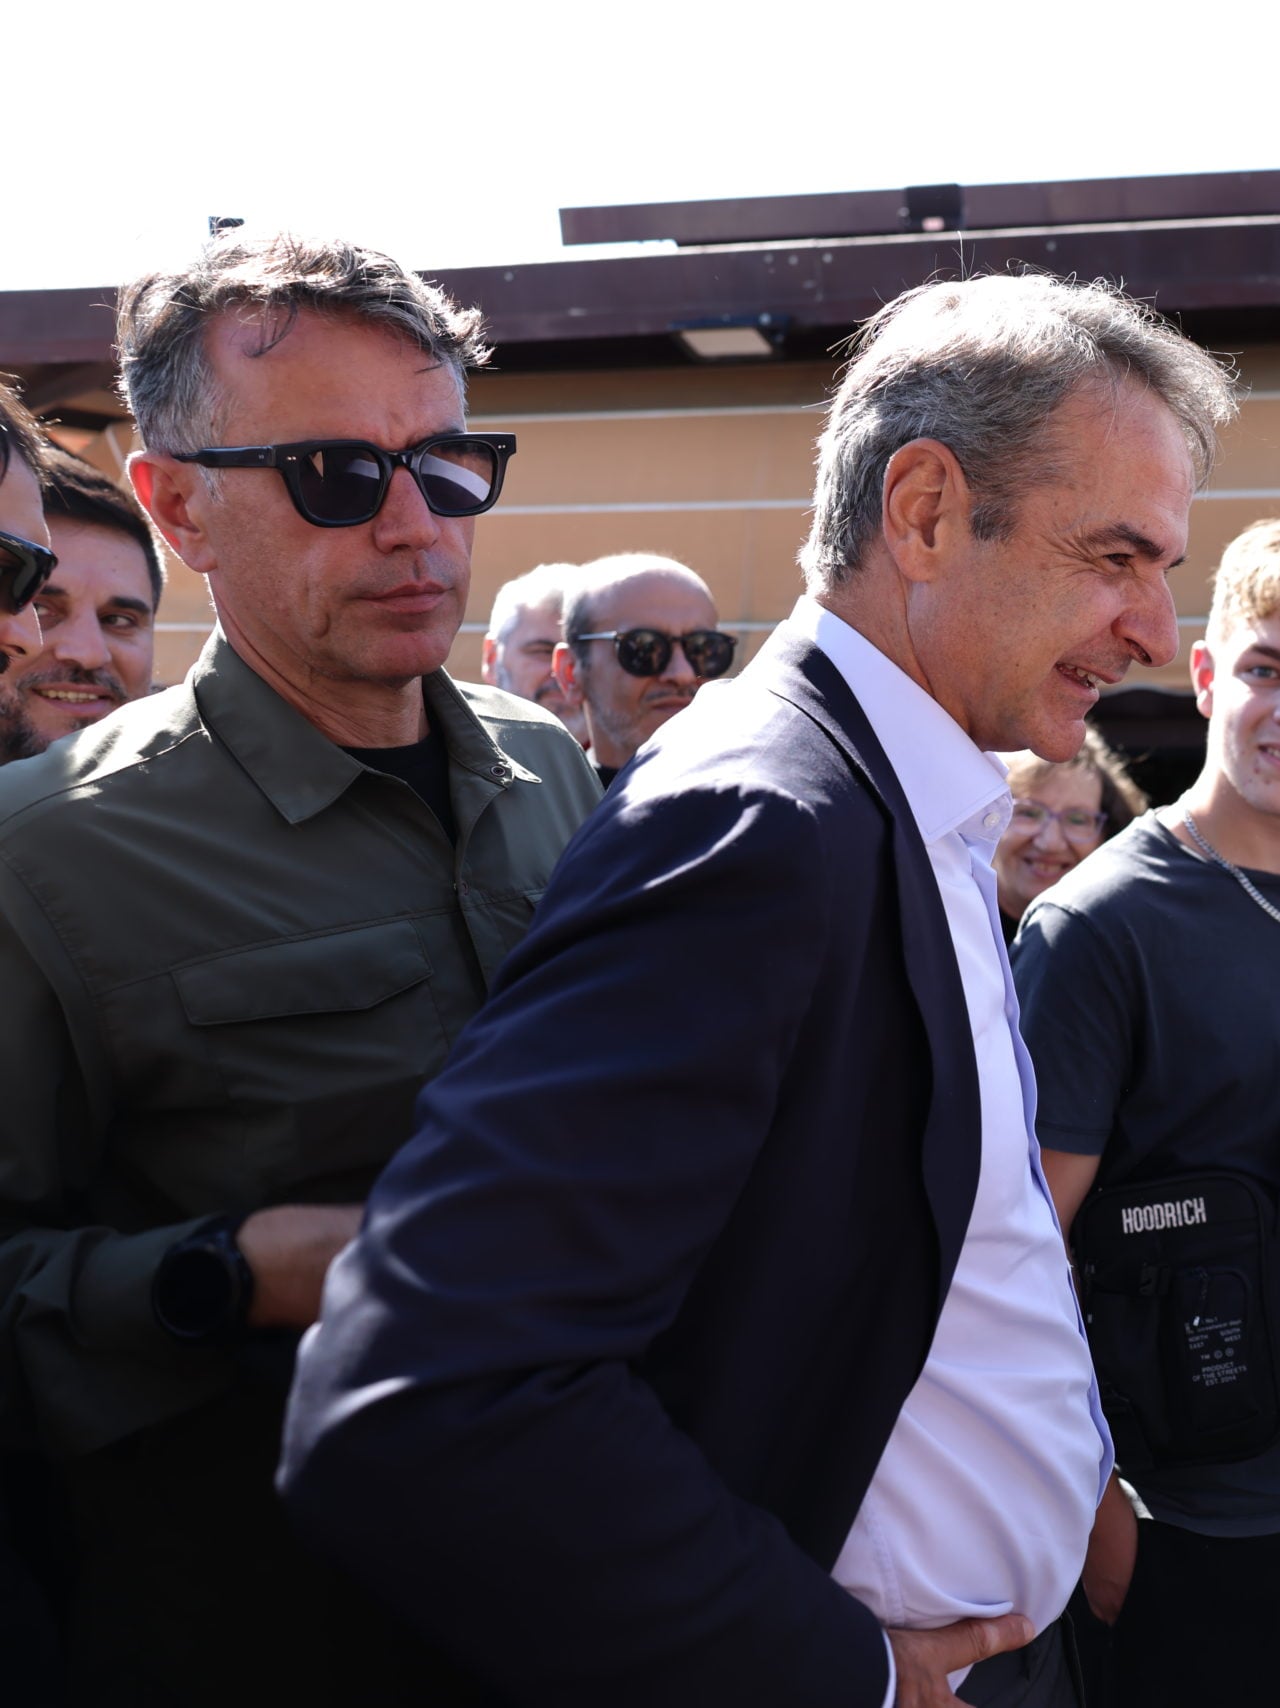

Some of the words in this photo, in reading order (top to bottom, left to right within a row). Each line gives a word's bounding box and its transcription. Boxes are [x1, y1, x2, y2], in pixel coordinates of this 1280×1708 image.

[1121, 1197, 1207, 1234] HOODRICH
[1202, 1361, 1234, 1372] PRODUCT
[1202, 1371, 1215, 1379] THE
[1217, 1365, 1247, 1377] STREETS
